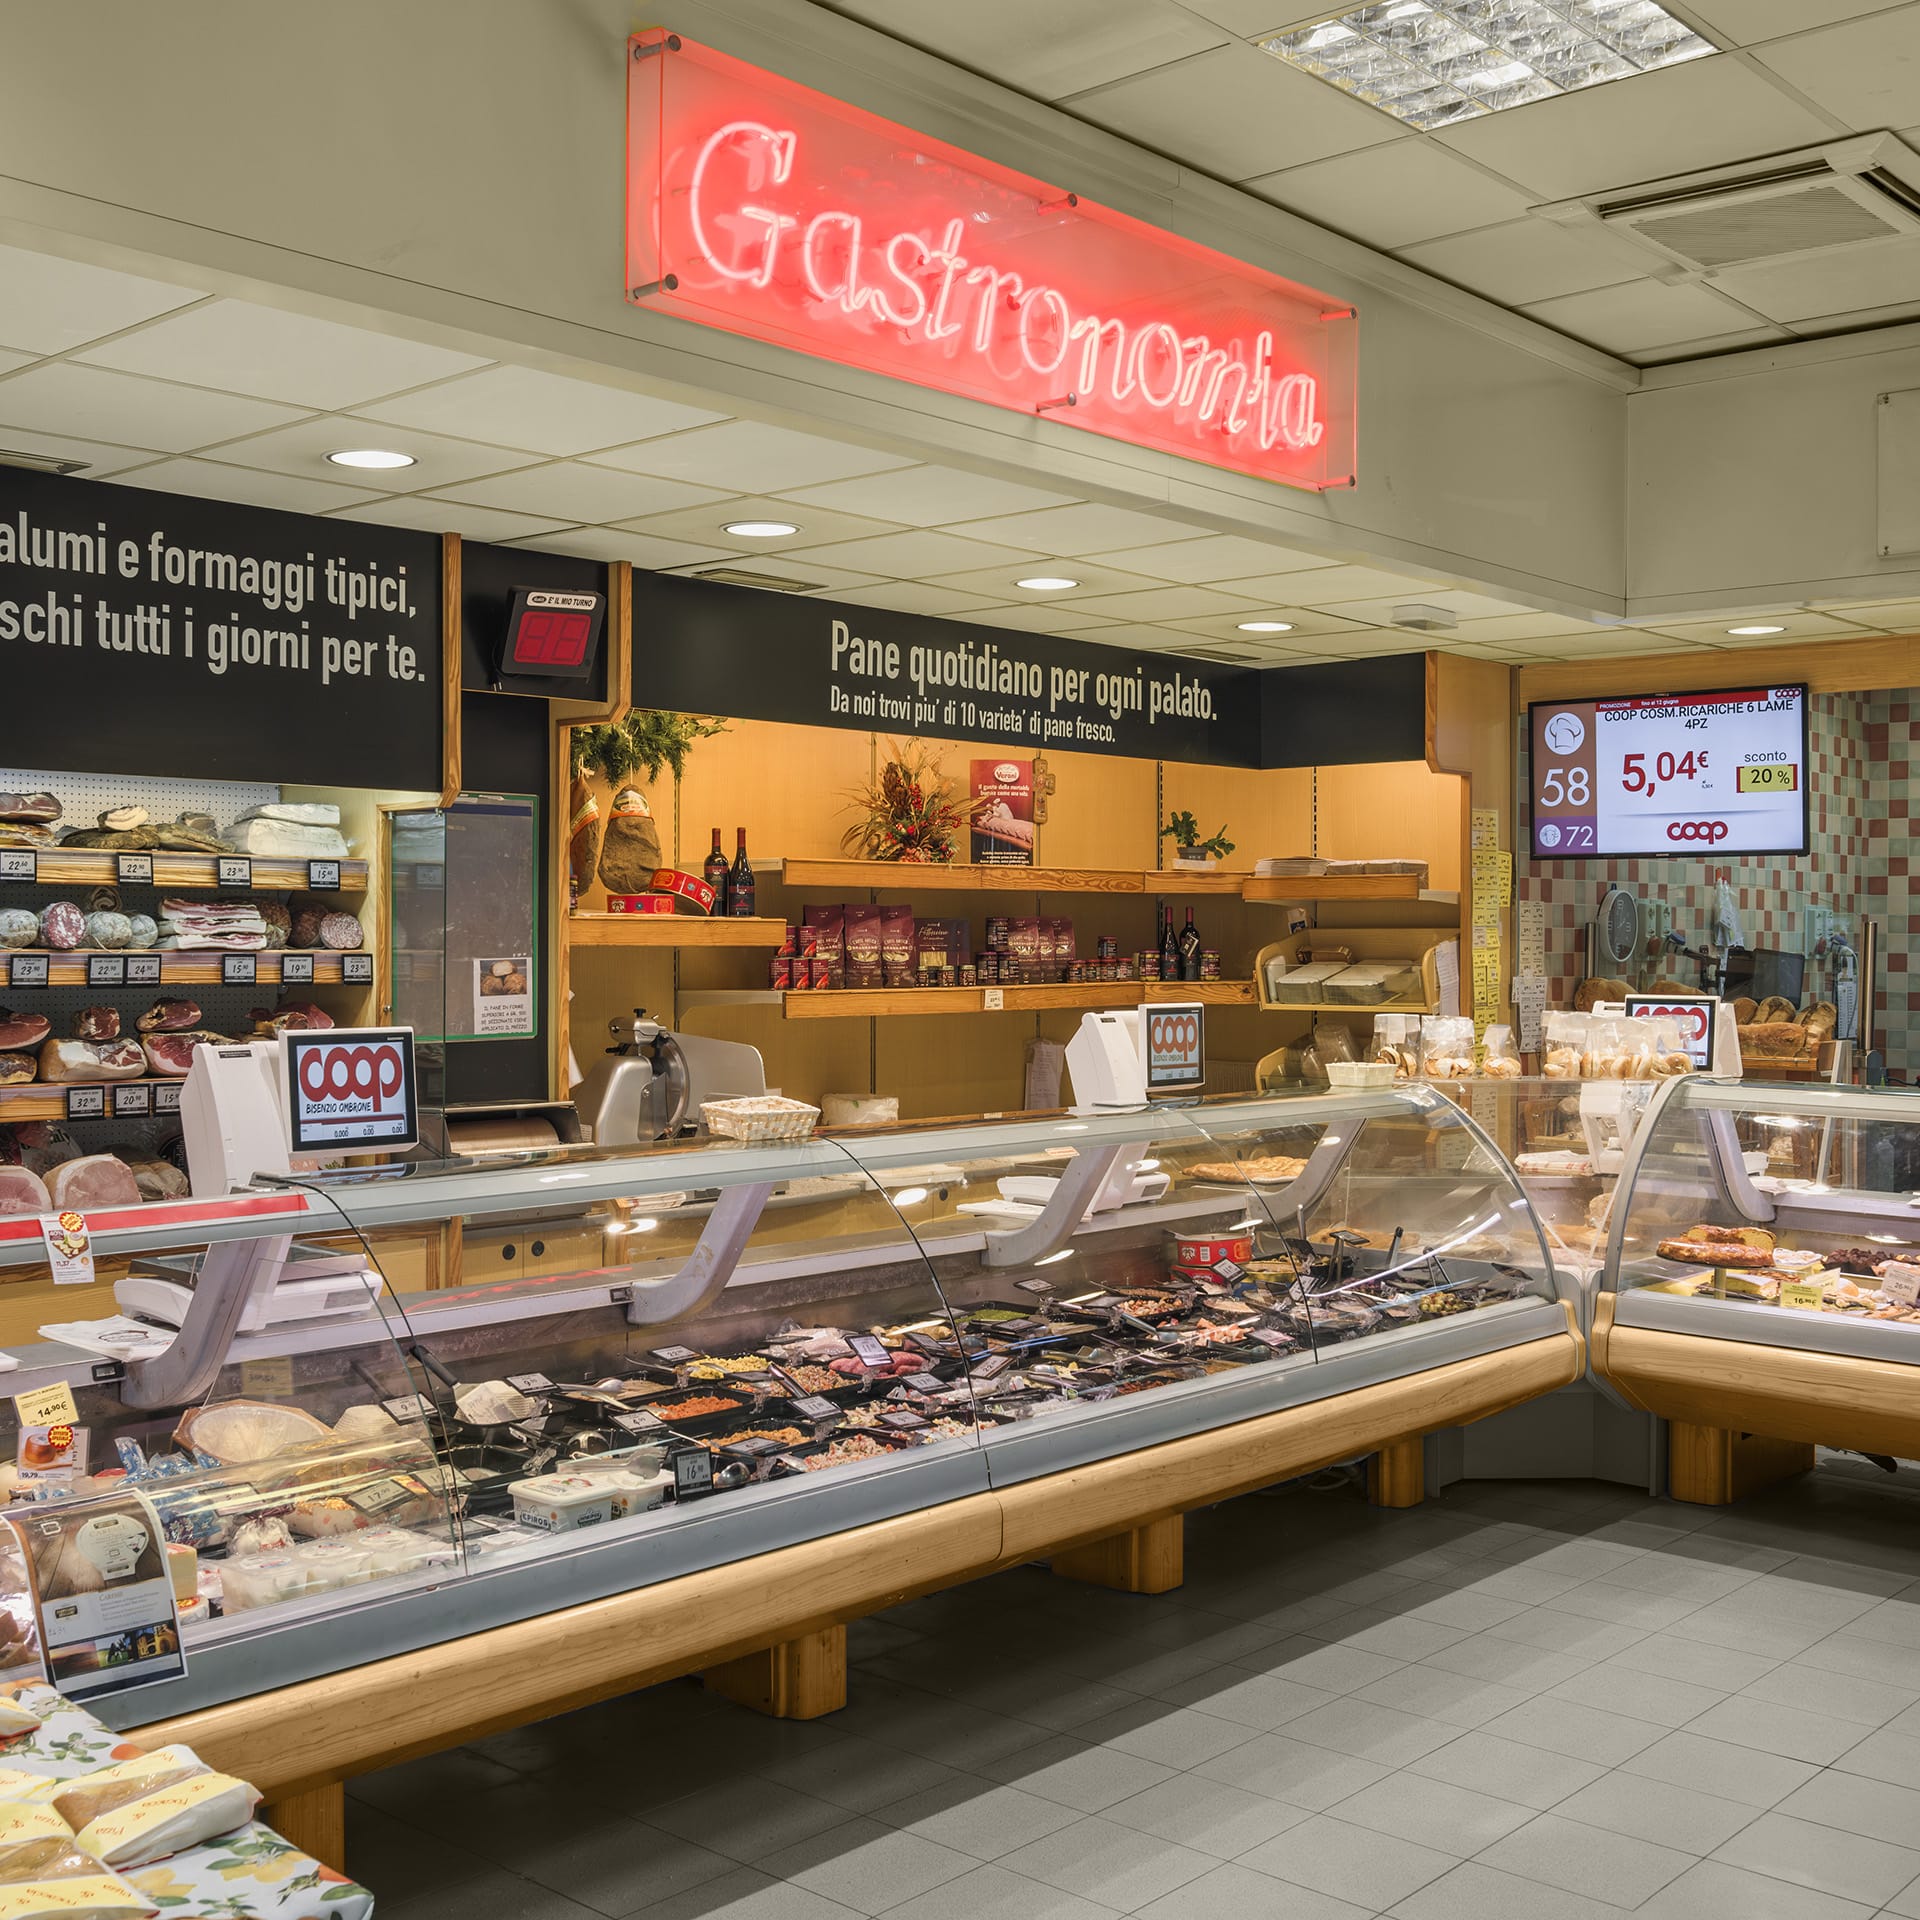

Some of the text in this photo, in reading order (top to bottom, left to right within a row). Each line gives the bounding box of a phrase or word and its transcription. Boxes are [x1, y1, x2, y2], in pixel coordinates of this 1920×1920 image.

[689, 120, 1324, 450] Gastronomia
[118, 540, 139, 578] e
[148, 531, 314, 613] formaggi
[325, 557, 416, 620] tipici,
[573, 599, 593, 607] TURNO
[96, 600, 170, 655] tutti
[185, 607, 193, 657] i
[208, 612, 309, 675] giorni
[322, 636, 378, 685] per
[386, 634, 425, 682] te.
[831, 620, 1217, 724] Pane quotidiano per ogni palato.
[1774, 687, 1801, 699] coop
[830, 685, 848, 713] Da
[854, 690, 875, 716] noi
[879, 693, 910, 720] trovi
[944, 700, 956, 725] di
[961, 702, 976, 727] 10
[1029, 711, 1041, 735] di
[1044, 717, 1073, 742] pane
[1076, 716, 1116, 743] fresco.
[1605, 700, 1794, 722] COOP COSM.RICARICHE 6 LAME
[1685, 718, 1708, 729] 4PZ
[1744, 751, 1787, 763] sconto
[1540, 766, 1590, 807] 58
[1751, 768, 1772, 784] 20
[1566, 826, 1593, 847] 72
[1667, 820, 1729, 844] coop
[1151, 1015, 1198, 1062] coop
[300, 1045, 403, 1112] coop
[306, 1102, 371, 1114] BISENZIO OMBRONE
